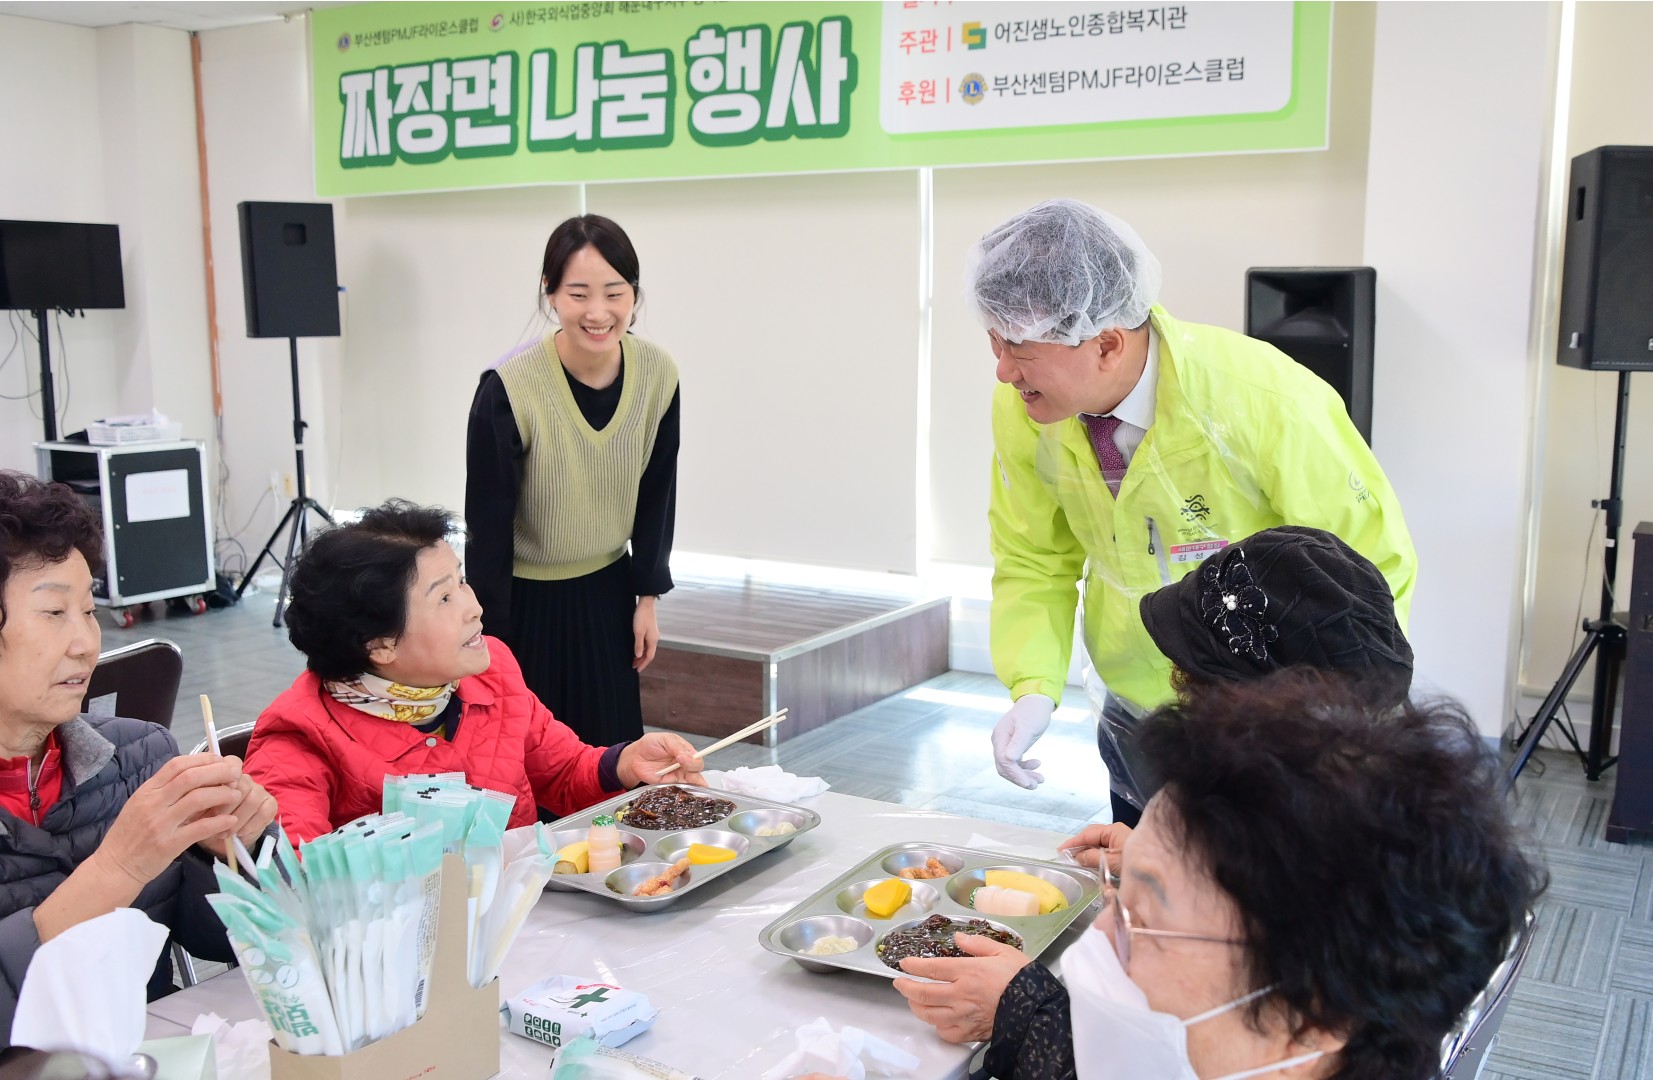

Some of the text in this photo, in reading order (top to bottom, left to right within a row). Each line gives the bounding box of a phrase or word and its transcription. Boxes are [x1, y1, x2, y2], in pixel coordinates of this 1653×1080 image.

[355, 17, 479, 47] 부산센텀PMJF라이온스클럽
[994, 5, 1188, 43] 어진샘노인종합복지관
[899, 28, 938, 55] 주관
[340, 19, 849, 161] 짜장면 나눔 행사
[898, 79, 936, 106] 후원
[992, 57, 1246, 97] 부산센텀PMJF라이온스클럽
